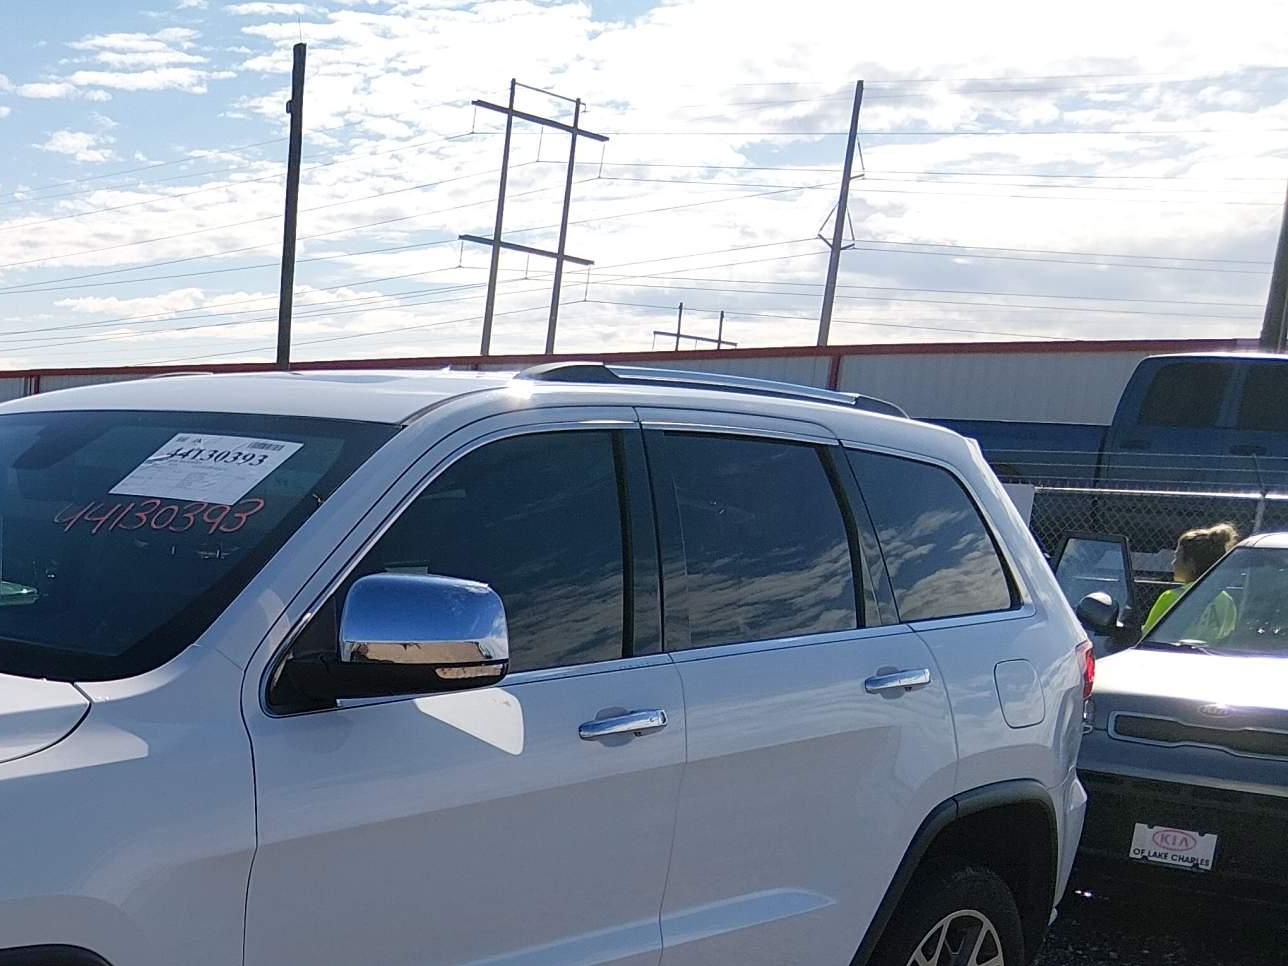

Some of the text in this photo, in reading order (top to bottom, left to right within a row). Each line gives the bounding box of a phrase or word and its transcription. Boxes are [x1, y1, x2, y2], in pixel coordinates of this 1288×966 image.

[54, 498, 265, 535] 44130393
[1159, 833, 1190, 848] KIA
[1133, 847, 1210, 866] OF LAKE CHARLES
